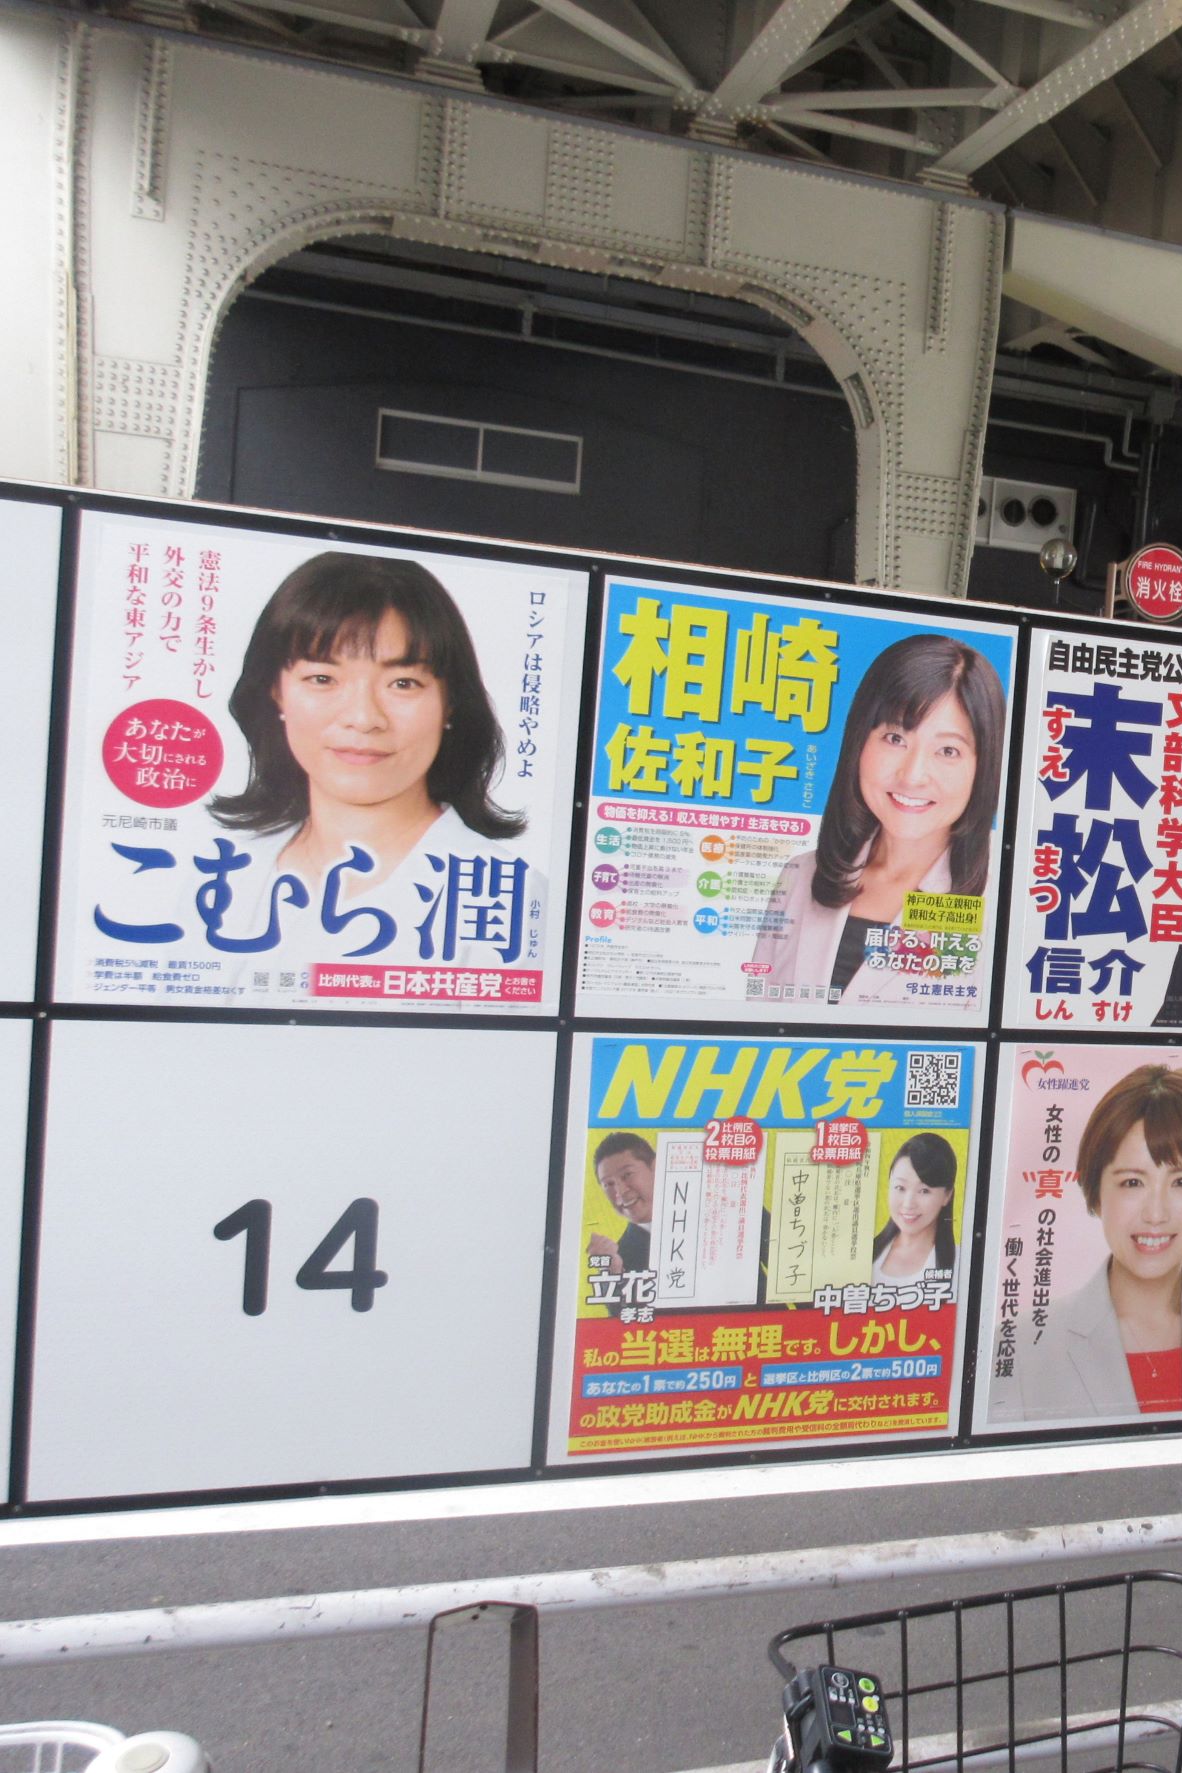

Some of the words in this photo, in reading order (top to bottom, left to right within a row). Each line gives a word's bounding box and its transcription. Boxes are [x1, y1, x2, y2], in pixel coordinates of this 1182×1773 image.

[1137, 560, 1153, 570] FIRE
[159, 546, 186, 654] 外交の力で
[121, 542, 151, 692] 平和な東アジア
[612, 597, 839, 734] 相崎
[515, 590, 547, 779] ロシアは侵略やめよ
[127, 718, 207, 743] あなたが
[1038, 704, 1073, 781] すえ
[113, 741, 208, 767] 大切にされる
[604, 721, 799, 803] 佐和子
[135, 767, 197, 790] 政治に
[101, 814, 178, 831] 元尼崎市議
[748, 817, 805, 832] 生活を守る!
[1037, 681, 1164, 945] 末松
[596, 835, 622, 847] 生活
[592, 871, 618, 883] 子育て
[1029, 846, 1062, 913] まつ
[93, 836, 530, 963] こむら潤
[529, 899, 540, 920] 小村
[907, 894, 982, 909] 神戸の私立親和中
[590, 909, 615, 921] 教育
[694, 915, 719, 926] 平和
[527, 928, 539, 958] じゅん
[585, 935, 612, 944] Profile
[864, 927, 982, 951] 届ける、叶える
[867, 951, 976, 973] あなたの声を
[1026, 946, 1146, 998] 信介
[319, 973, 381, 989] 比例代表は
[384, 971, 503, 998] 日本共産党
[505, 977, 536, 987] とお書き
[505, 987, 536, 996] ください
[919, 983, 978, 998] 立憲民主党
[1034, 999, 1074, 1022] しん
[1091, 1000, 1134, 1023] すけ
[597, 1044, 898, 1120] NHK党
[1037, 1077, 1090, 1092] 女性躍進党
[706, 1120, 721, 1146] 2
[722, 1122, 754, 1133] 比例区
[721, 1133, 756, 1146] 枚目の
[817, 1122, 825, 1147] 1
[828, 1122, 858, 1133] 選挙区
[827, 1133, 861, 1145] 枚目の
[704, 1147, 756, 1161] 投票用紙
[811, 1147, 862, 1161] 投票用紙
[667, 1180, 690, 1290] NHK党
[213, 1197, 389, 1317] 14
[590, 1256, 611, 1268] 党首
[586, 1269, 658, 1304] 立花
[924, 1268, 952, 1281] 候補者
[814, 1281, 953, 1316] 中曽ちづ子
[995, 1236, 1024, 1378] 働く世代を応援
[620, 1307, 655, 1324] 孝志
[829, 1318, 943, 1356] しかし、
[586, 1370, 737, 1396] あなたの1票で約250円
[744, 1374, 758, 1388] と
[763, 1360, 939, 1384] 選挙区と比例区の2票で約500円
[580, 1390, 941, 1428] の政党助成金がNHK党に交付されます。
